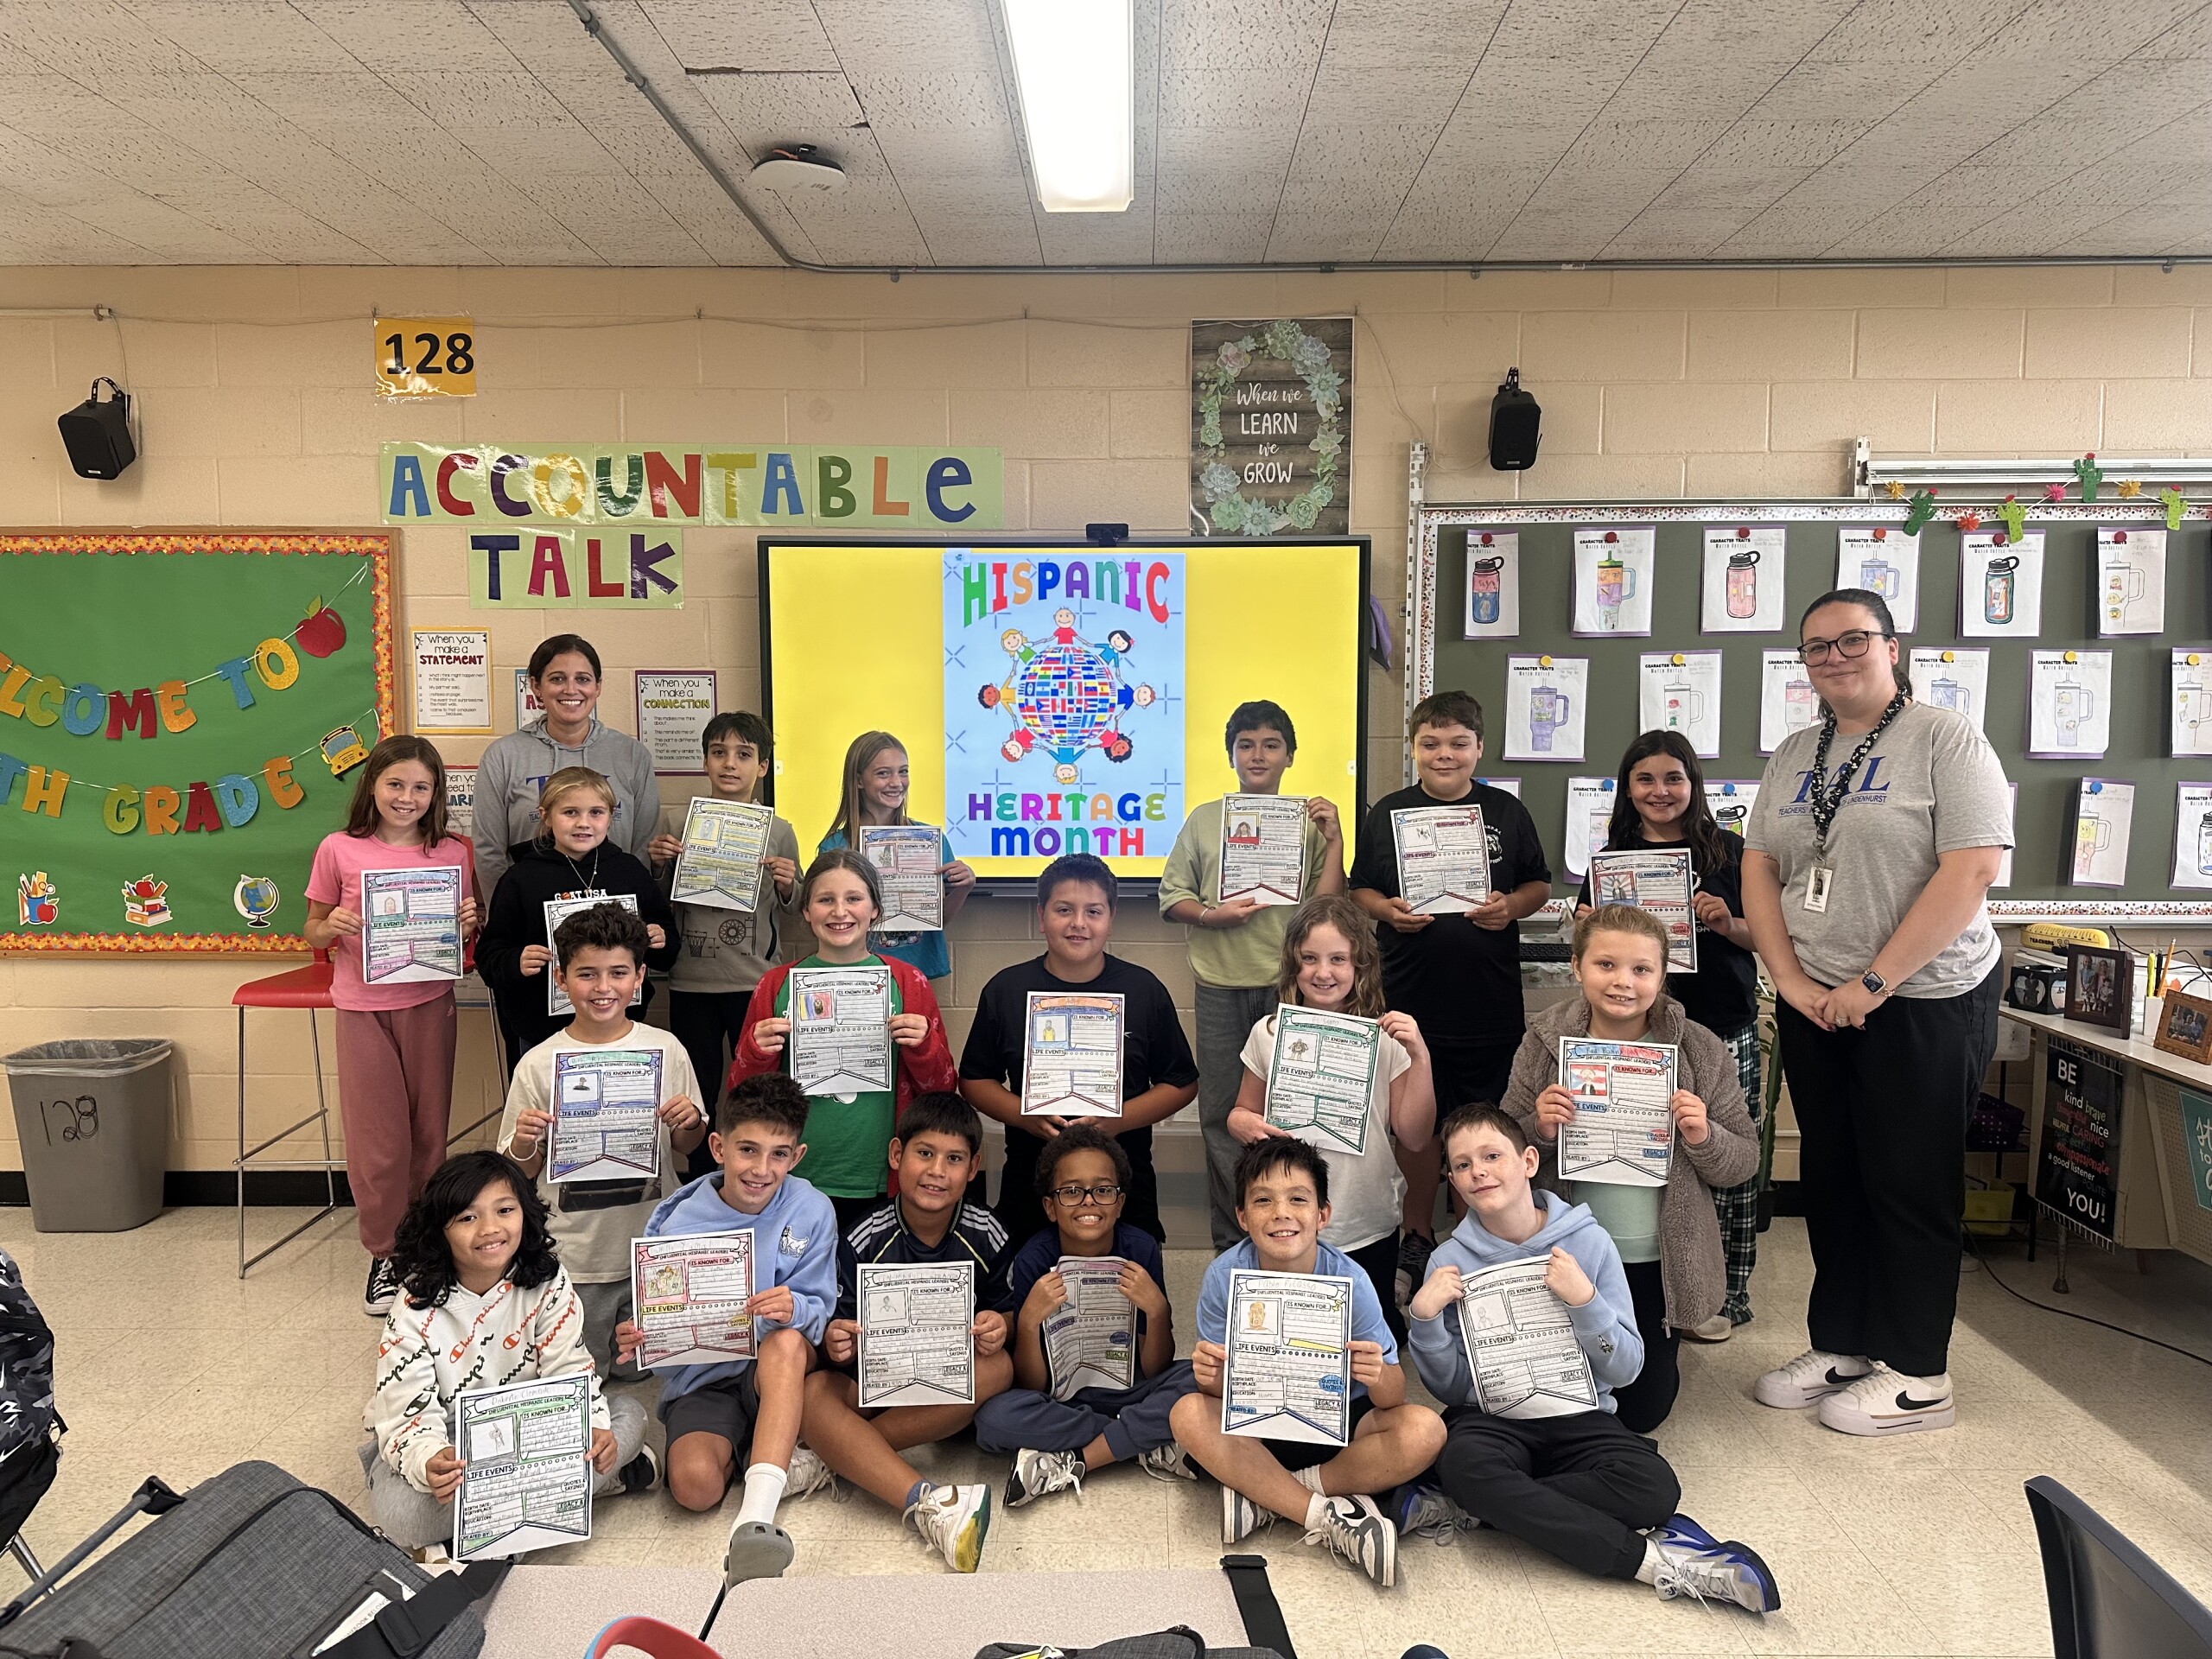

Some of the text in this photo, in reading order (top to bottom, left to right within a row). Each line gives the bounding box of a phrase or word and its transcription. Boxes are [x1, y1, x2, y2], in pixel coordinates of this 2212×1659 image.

[385, 332, 474, 375] 128
[1236, 383, 1303, 406] When we
[1241, 412, 1298, 435] LEARN
[1259, 442, 1279, 457] we
[1243, 461, 1294, 484] GROW
[389, 452, 977, 523] ACCOUNTABLE
[470, 534, 679, 601] TALK
[963, 561, 1170, 628] HISPANIC
[428, 635, 474, 645] When you
[435, 645, 461, 654] make
[419, 655, 484, 665] STATEMENT
[215, 638, 300, 709] TO
[681, 680, 700, 689] you
[643, 699, 710, 709] CONNECTION
[1789, 756, 1891, 804] TAL
[102, 756, 305, 836] GRADE
[1847, 795, 1887, 804] LINDENHURST
[969, 792, 1166, 822] HERITAGE
[991, 826, 1144, 856] MONTH
[584, 888, 607, 899] USA
[1290, 1067, 1312, 1077] EVENTS
[2057, 1058, 2077, 1084] BE
[1582, 1103, 1605, 1111] EVENTS
[2064, 1089, 2107, 1122] kind brave
[41, 1095, 99, 1147] 128
[2090, 1122, 2109, 1138] nice
[2072, 1125, 2105, 1148] CARING
[2053, 1154, 2070, 1169] good
[2070, 1162, 2095, 1182] listener
[2067, 1187, 2106, 1224] YOU!
[658, 1304, 683, 1313] EVENTS
[1250, 1344, 1275, 1353] EVENTS
[1489, 1335, 1513, 1345] EVENTS
[488, 1404, 519, 1416] INFLUENTIAL
[520, 1399, 543, 1408] HISPANIC
[531, 1408, 553, 1417] KNOWN
[467, 1465, 512, 1479] LIFE EVENTS
[564, 1483, 585, 1491] SAYINGS
